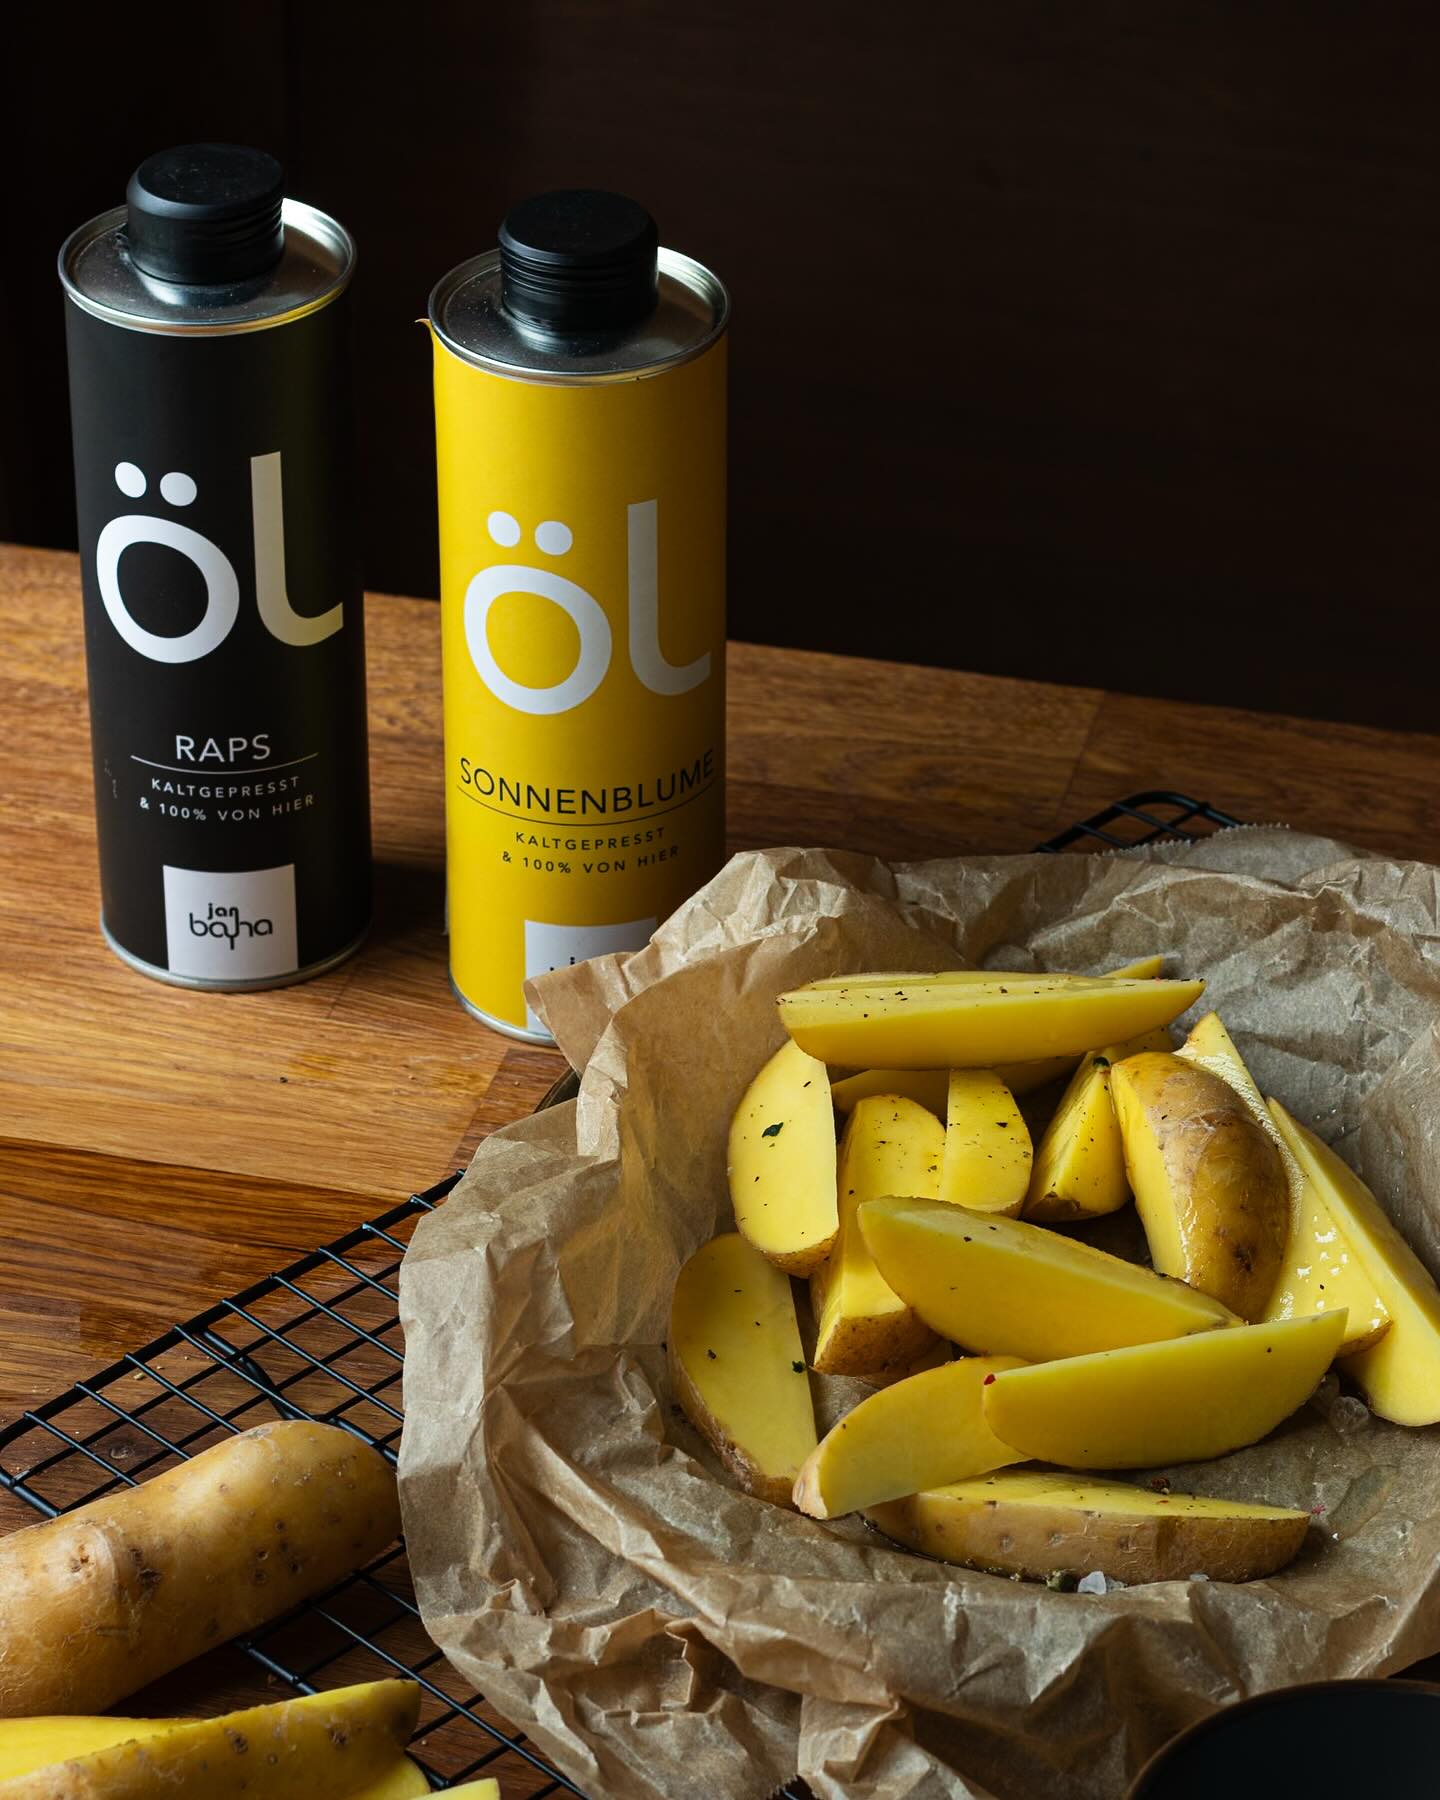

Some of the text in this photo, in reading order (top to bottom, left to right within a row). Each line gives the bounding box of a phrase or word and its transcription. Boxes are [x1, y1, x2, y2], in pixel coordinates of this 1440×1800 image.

[176, 734, 270, 762] RAPS
[152, 776, 299, 798] KALTGEPRESST
[460, 750, 714, 815] SONNENBLUME
[140, 794, 314, 821] & 100% VON HIER
[516, 827, 665, 850] KALTGEPRESST
[502, 846, 679, 874] & 100% VON HIER
[207, 902, 239, 920] jan
